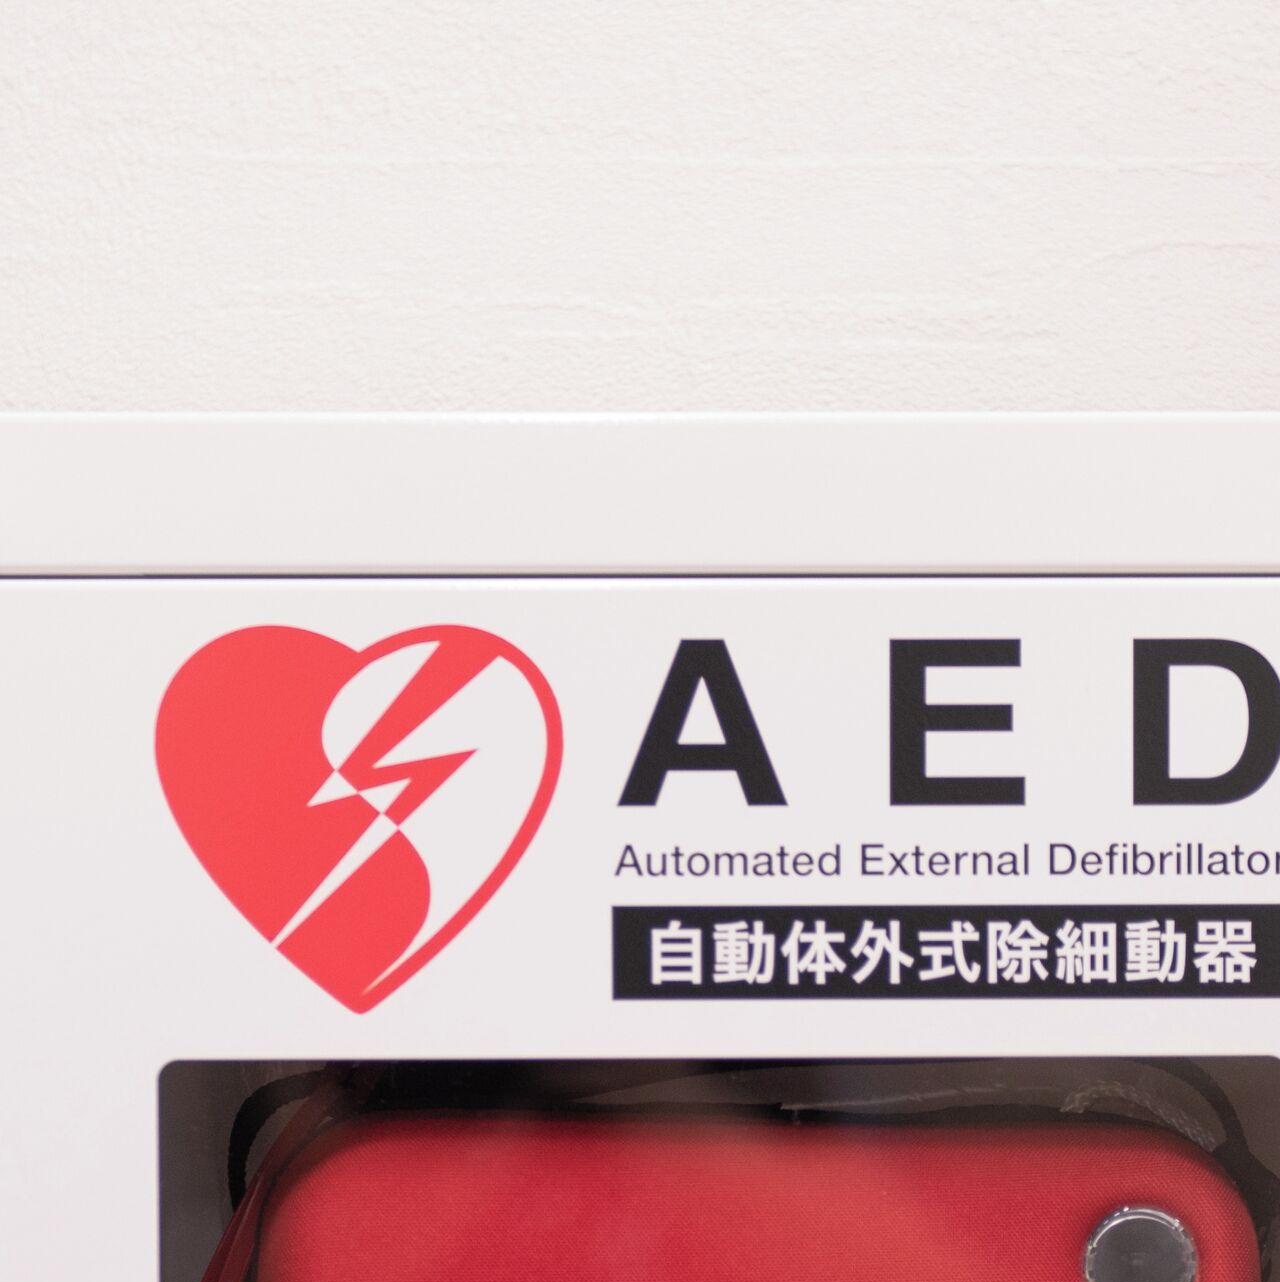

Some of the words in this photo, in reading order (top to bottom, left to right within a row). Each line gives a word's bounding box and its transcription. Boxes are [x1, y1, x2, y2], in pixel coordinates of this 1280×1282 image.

[613, 841, 841, 878] Automated
[859, 841, 1030, 878] External
[650, 918, 1258, 986] 自動体外式除細動器
